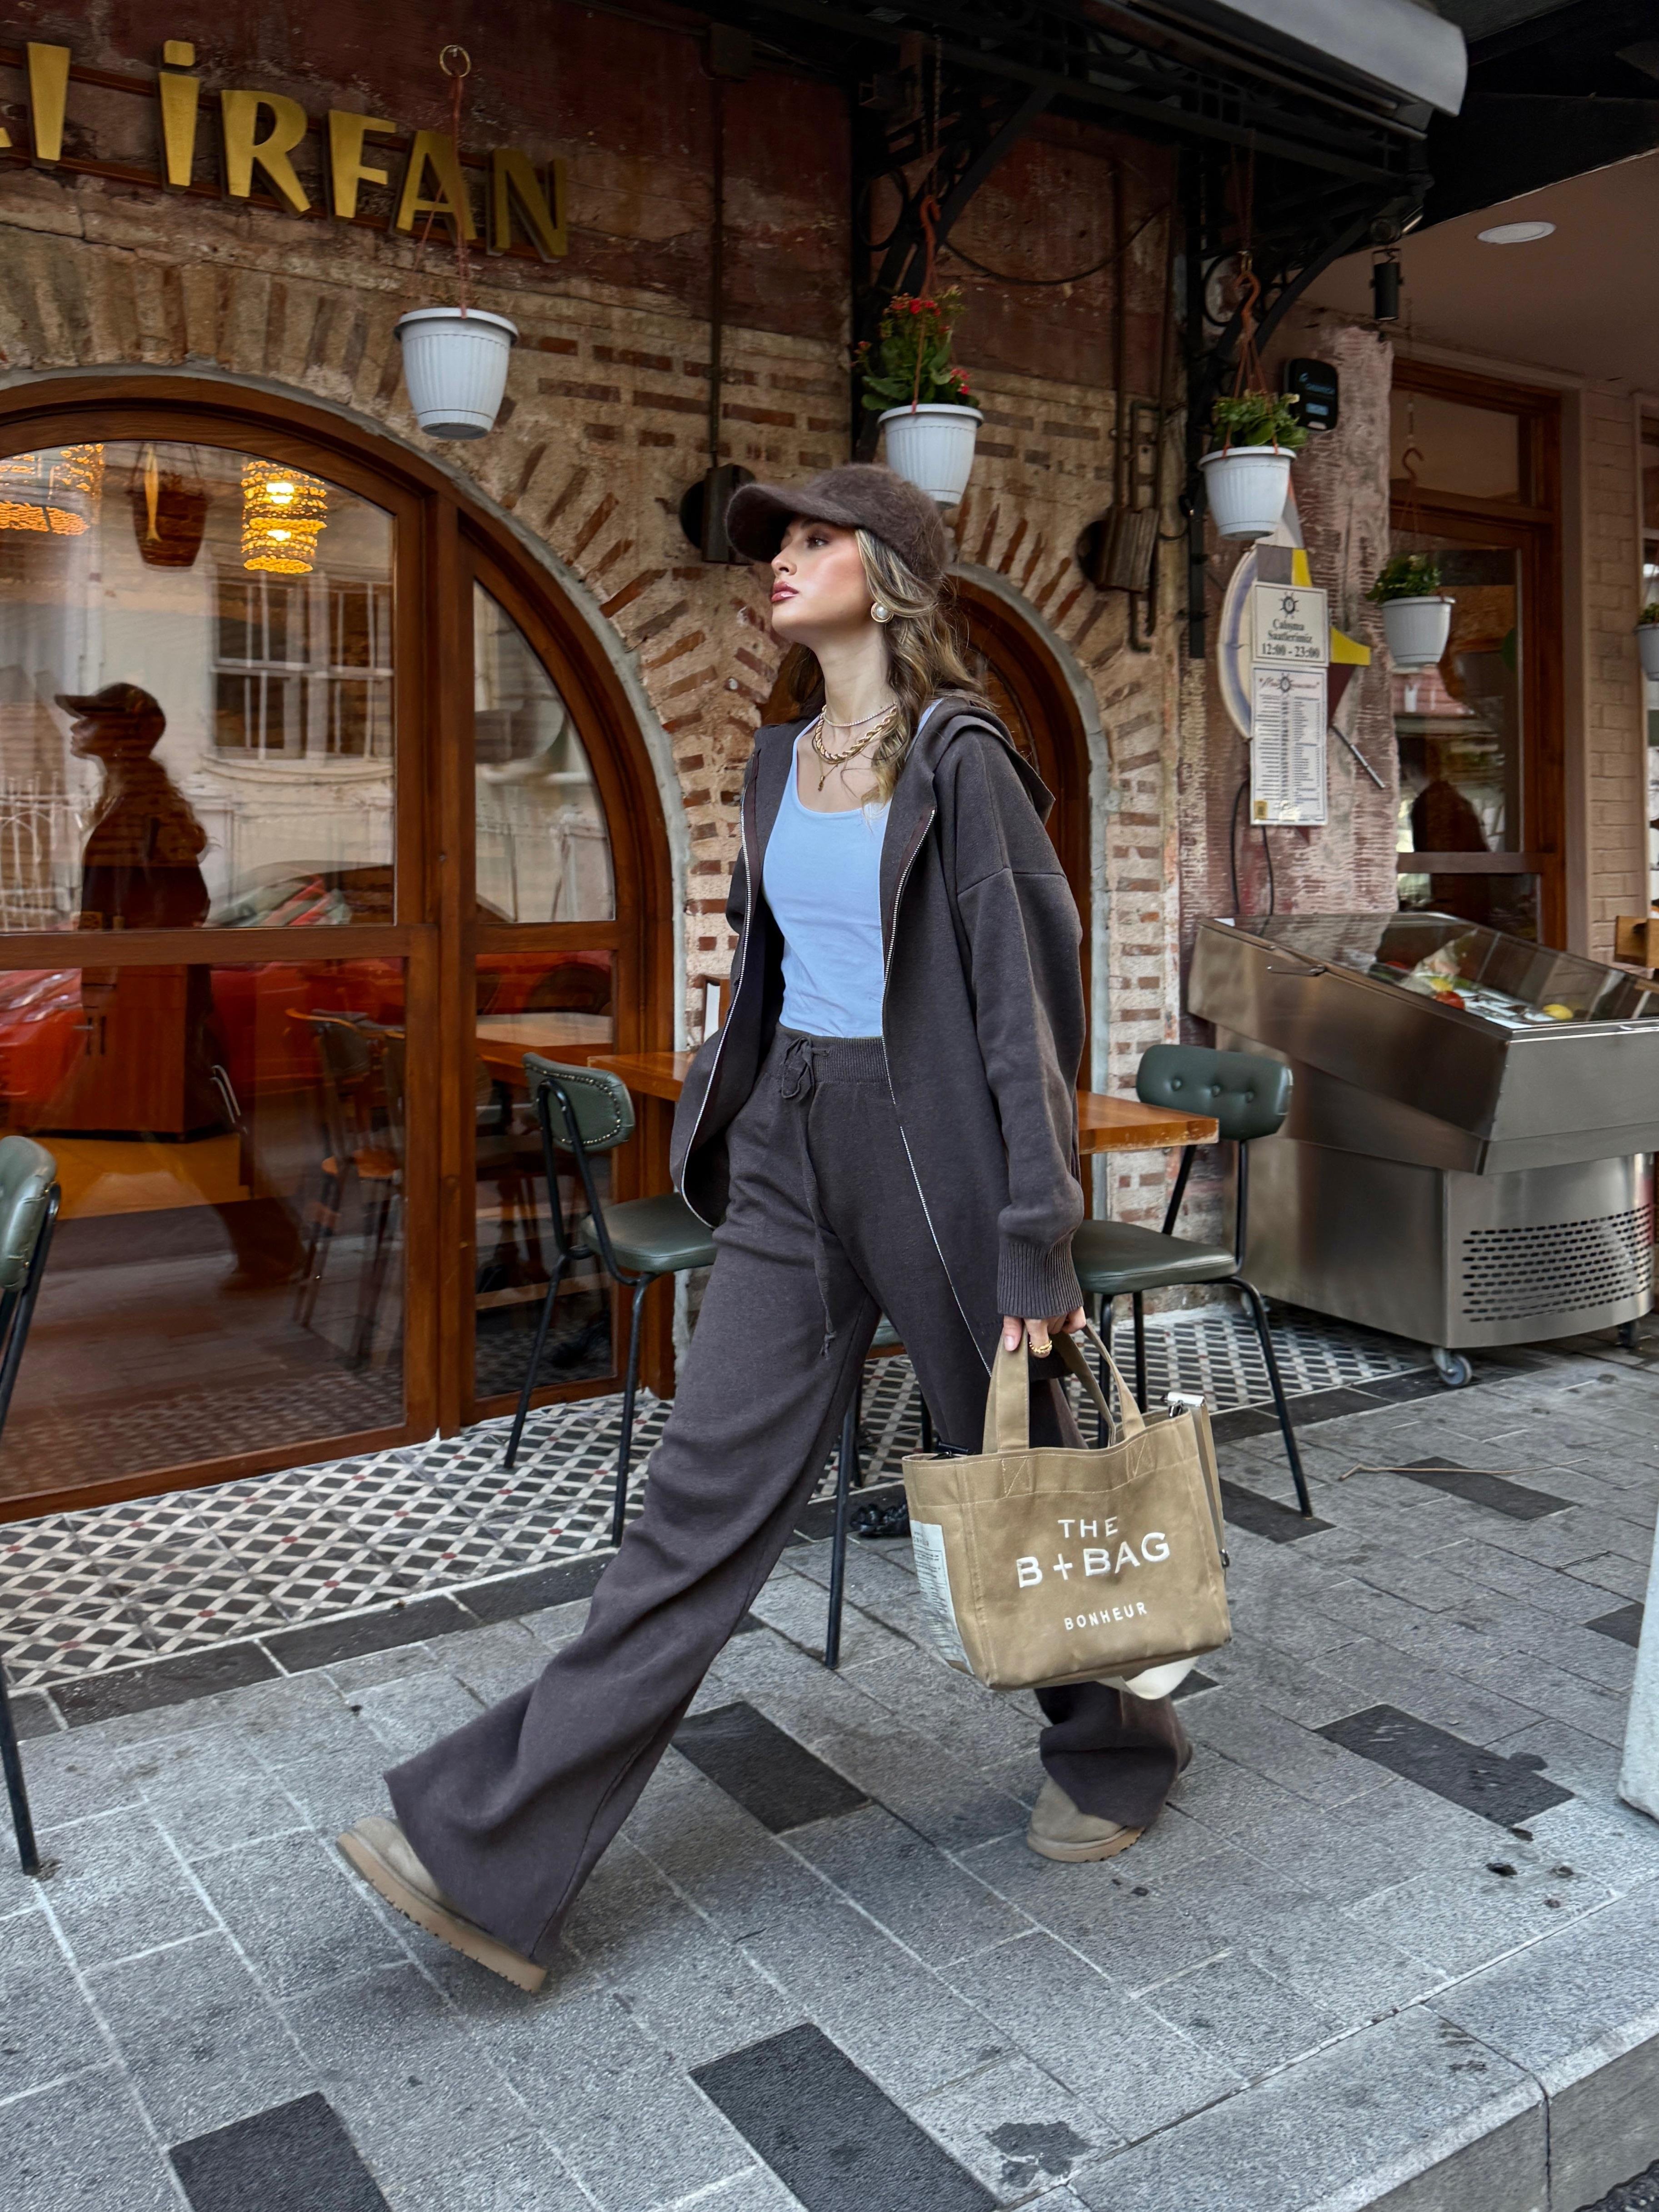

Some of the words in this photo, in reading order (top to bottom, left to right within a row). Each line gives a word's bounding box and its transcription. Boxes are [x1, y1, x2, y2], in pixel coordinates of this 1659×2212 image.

[159, 40, 567, 257] İRFAN
[1058, 1516, 1119, 1538] THE
[1064, 1602, 1148, 1630] BONHEUR
